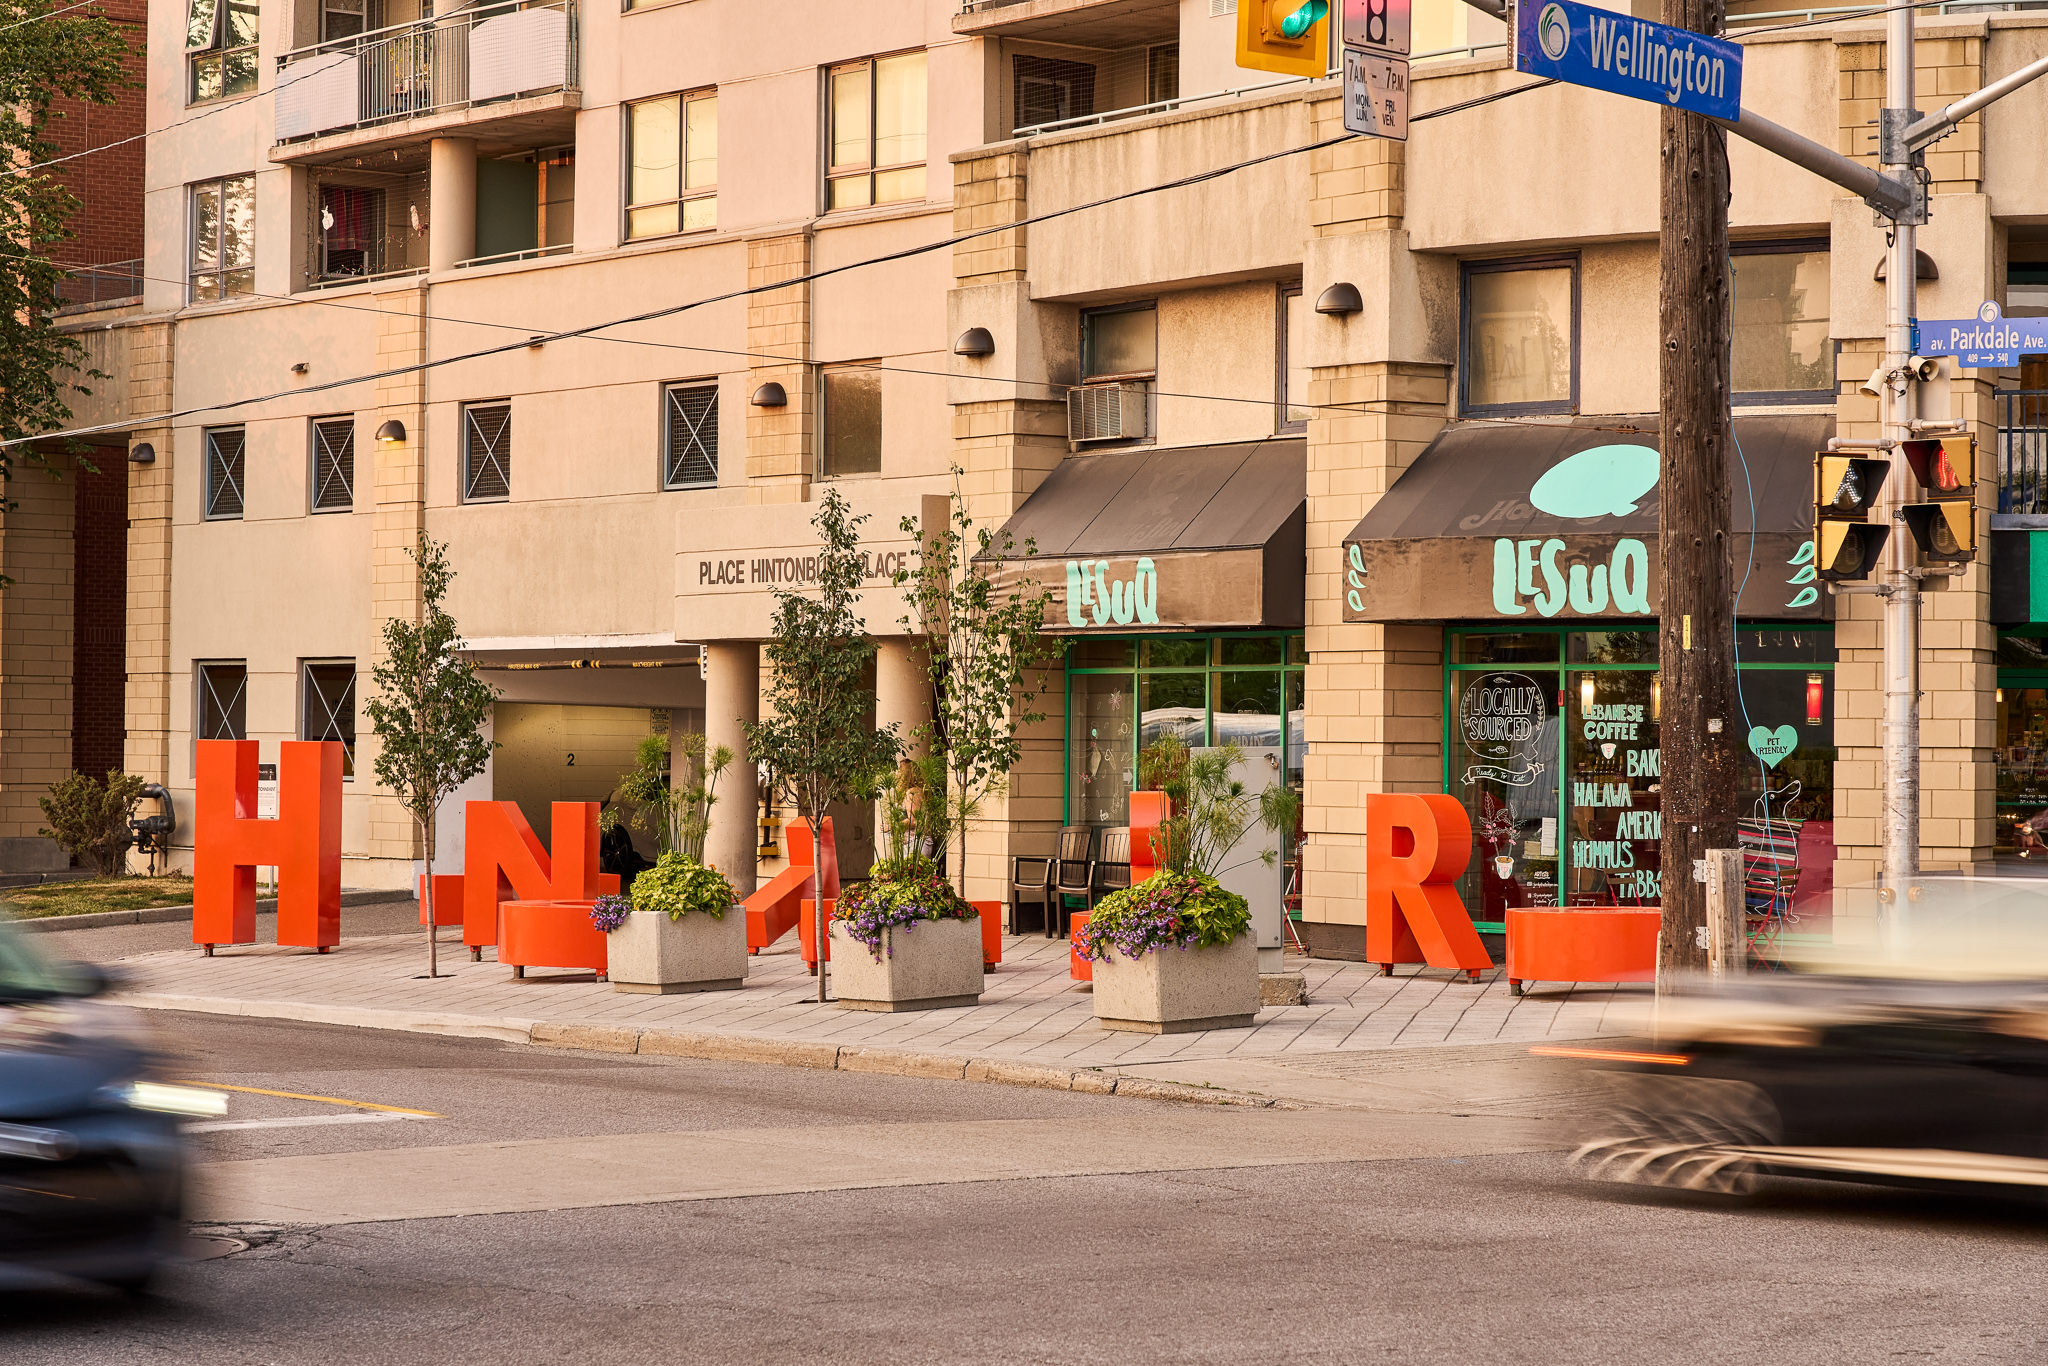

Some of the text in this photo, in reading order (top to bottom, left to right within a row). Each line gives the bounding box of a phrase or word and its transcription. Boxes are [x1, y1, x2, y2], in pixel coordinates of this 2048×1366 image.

[1590, 14, 1725, 103] Wellington
[1355, 93, 1371, 108] MON.
[1385, 99, 1397, 113] FRI.
[1382, 113, 1396, 127] VEN.
[1930, 324, 2047, 351] av. Parkdale Ave.
[1967, 352, 2009, 363] 409 540
[699, 560, 745, 585] PLACE
[1470, 686, 1536, 716] LOCALLY
[1582, 703, 1644, 723] LEBANESE
[1469, 716, 1532, 741] SOURCED
[1583, 720, 1639, 741] COFFEE
[1767, 737, 1780, 746] PET
[567, 753, 575, 766] 2
[1475, 767, 1497, 779] Ready
[1573, 781, 1633, 808] HALAWA
[1573, 840, 1635, 869] HUMMUS
